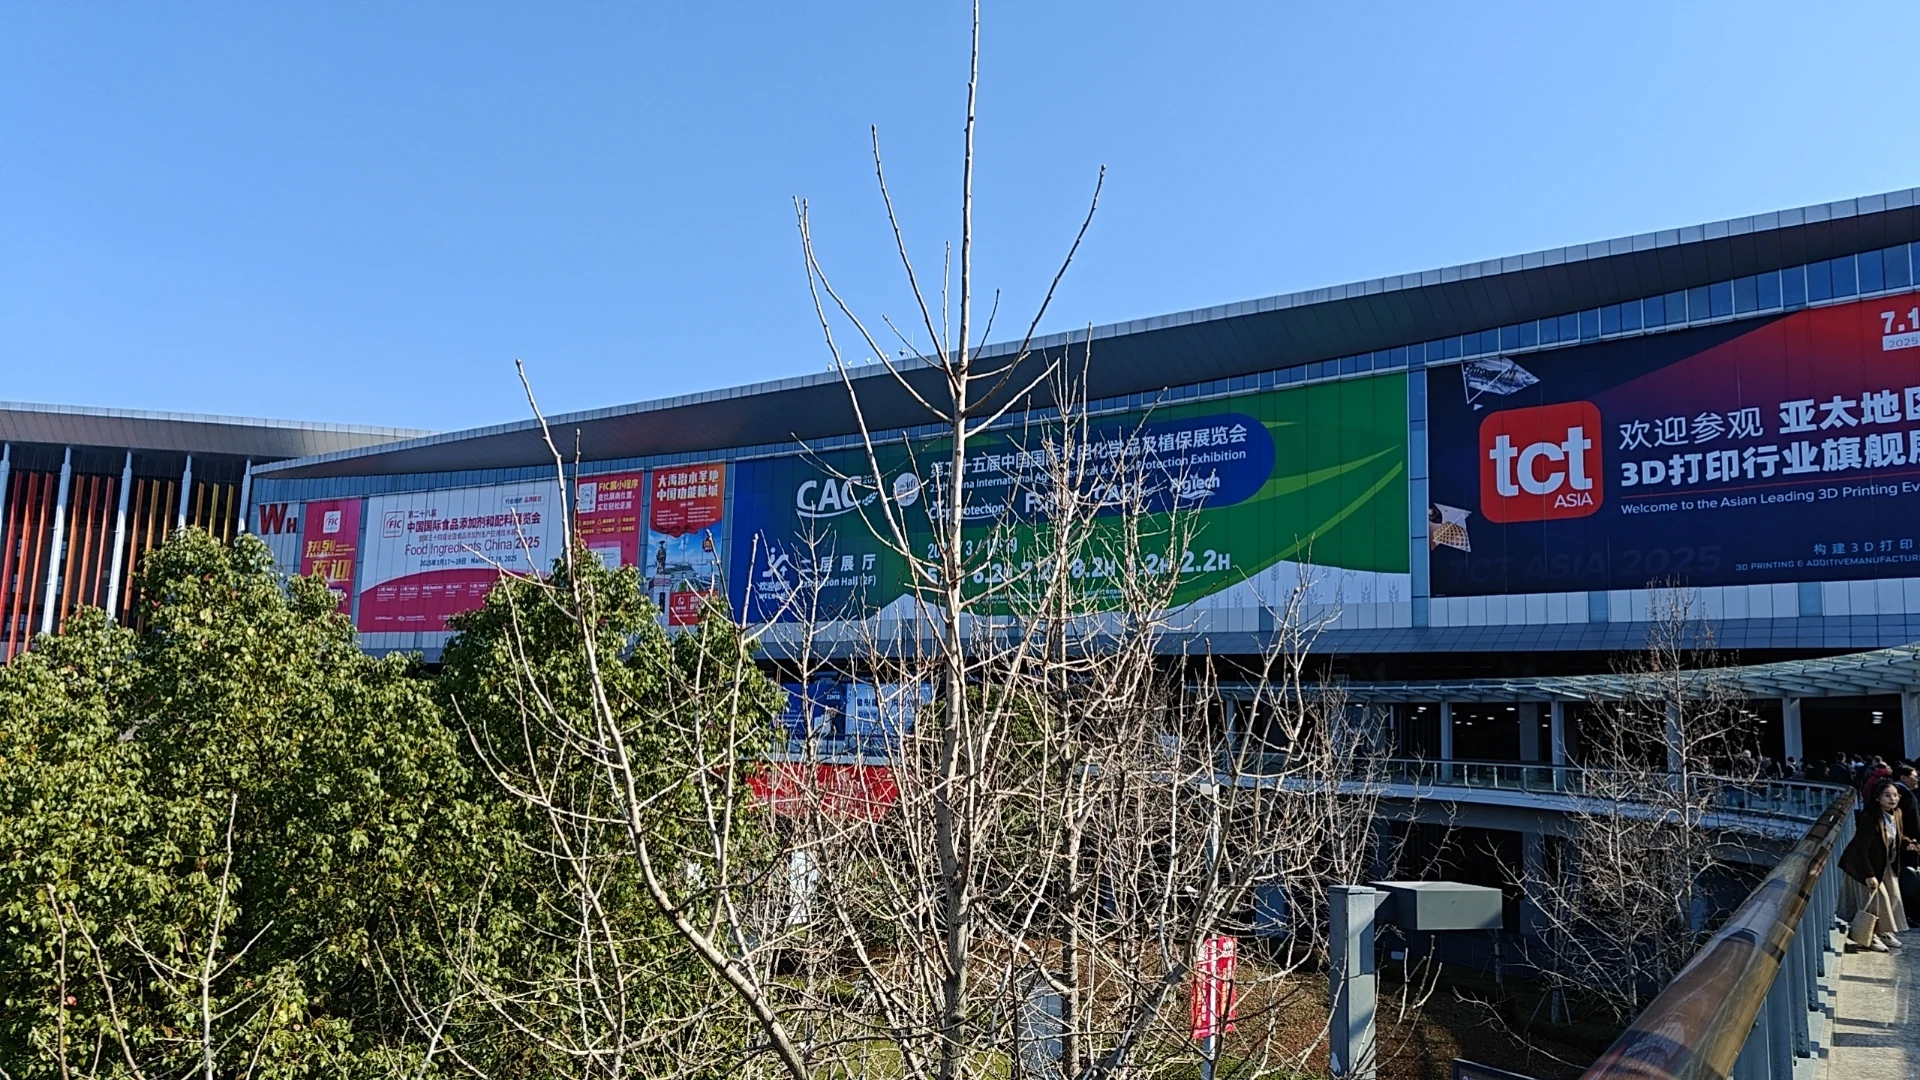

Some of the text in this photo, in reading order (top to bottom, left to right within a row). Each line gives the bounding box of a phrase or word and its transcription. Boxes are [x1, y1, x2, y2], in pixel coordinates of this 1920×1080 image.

[1889, 337, 1919, 348] 2025
[1619, 407, 1764, 451] 欢迎参观
[1191, 450, 1247, 465] Exhibition
[1489, 426, 1593, 497] tct
[796, 475, 862, 511] CAC
[1554, 492, 1593, 508] ASIA
[1621, 501, 1678, 515] Welcome
[1681, 500, 1695, 511] to
[1697, 498, 1718, 510] the
[1720, 496, 1757, 508] Asian
[1760, 490, 1815, 506] Leading
[1818, 488, 1838, 500] 3D
[1843, 483, 1899, 499] Printing
[388, 519, 402, 529] FIC
[407, 511, 542, 533] 中国国际食品添加剂和配料展览会
[405, 536, 540, 557] Food Ingredients China 2025
[1181, 549, 1231, 574] 2.2H
[1735, 563, 1748, 571] 3D
[1751, 560, 1795, 570] PRINTING
[841, 575, 859, 587] Hall
